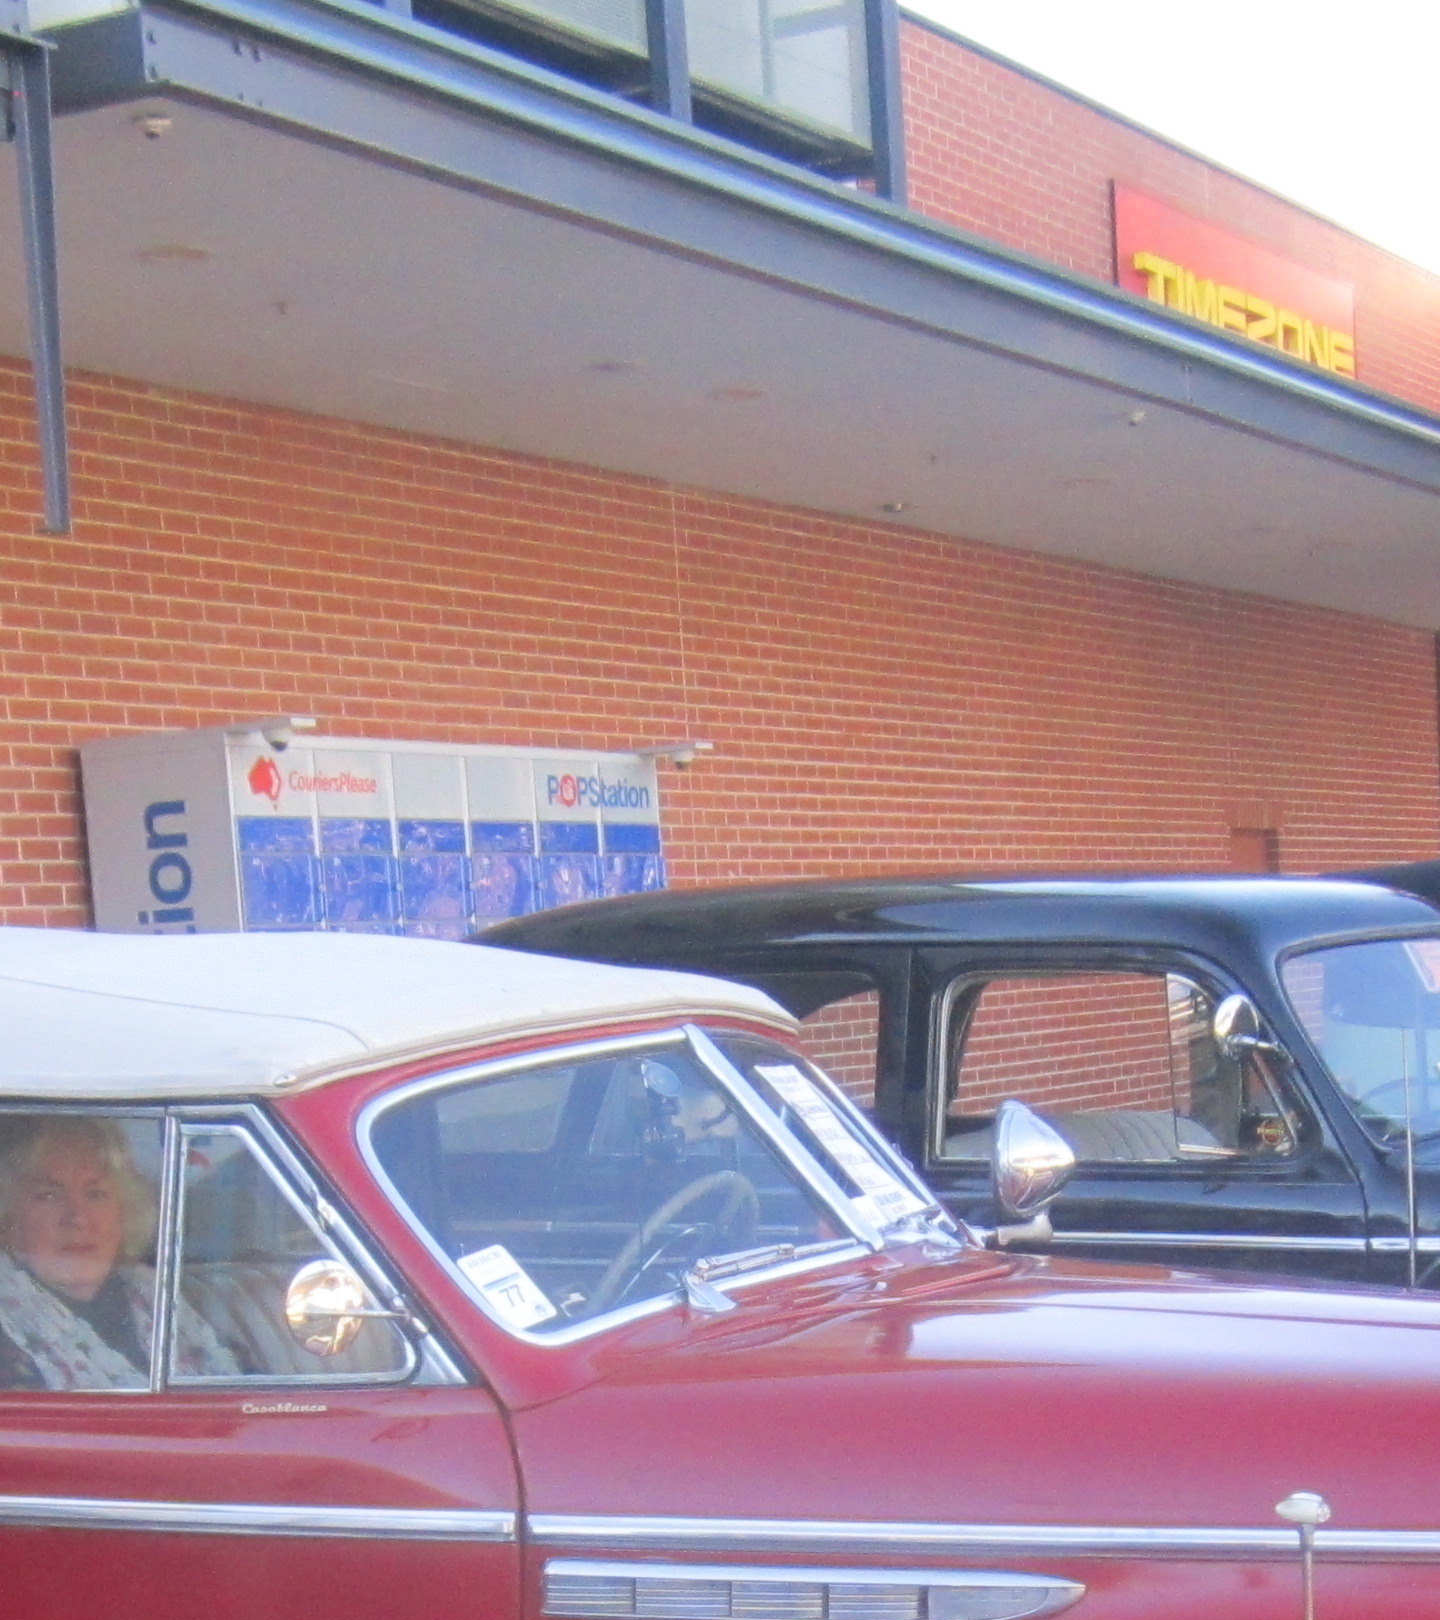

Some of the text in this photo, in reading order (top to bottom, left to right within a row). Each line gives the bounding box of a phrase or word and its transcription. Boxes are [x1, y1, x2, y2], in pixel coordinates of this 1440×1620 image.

[1133, 252, 1354, 381] TIMEZONE
[288, 770, 378, 794] CouriersPlease
[547, 773, 650, 808] POPStation
[137, 800, 196, 935] ion
[498, 1283, 526, 1308] 77
